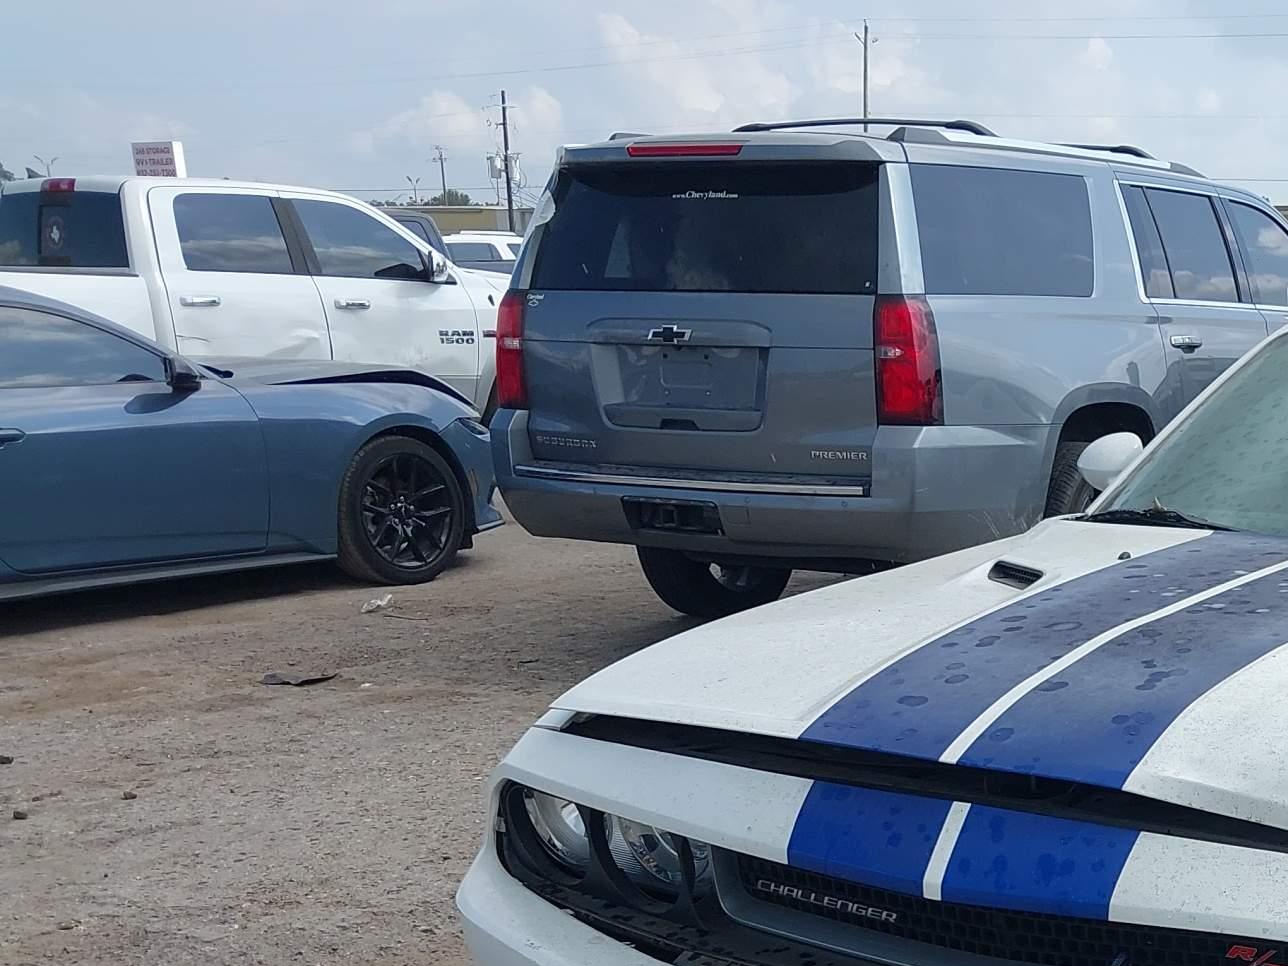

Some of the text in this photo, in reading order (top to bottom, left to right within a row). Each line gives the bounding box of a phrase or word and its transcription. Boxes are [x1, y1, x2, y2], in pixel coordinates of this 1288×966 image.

[439, 337, 475, 345] 1500
[811, 450, 868, 460] PREMIER
[756, 879, 898, 923] CHALLENGER
